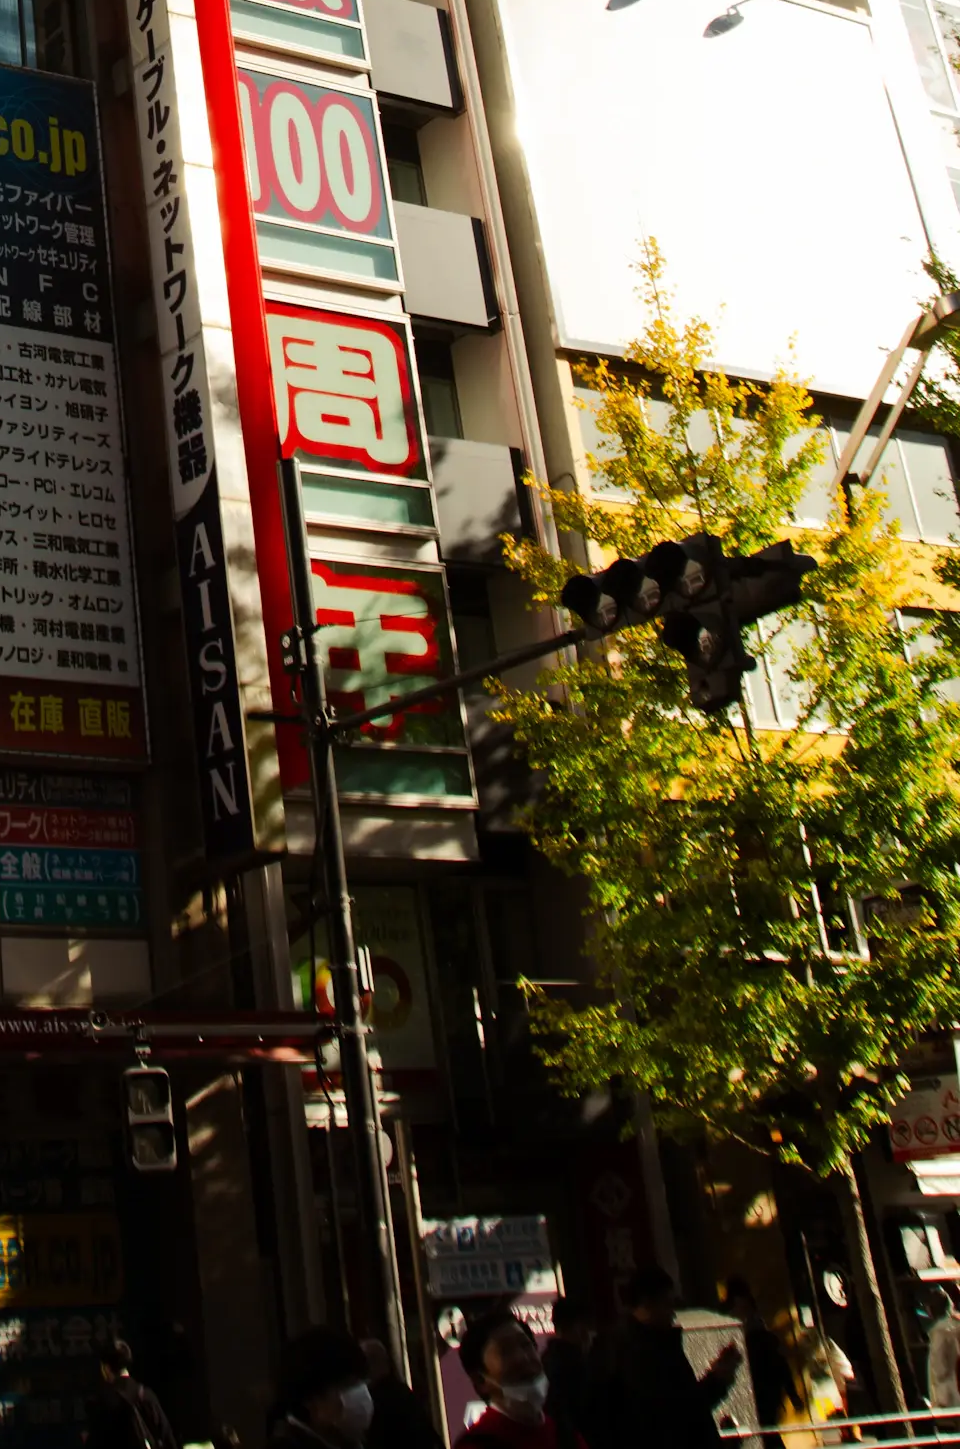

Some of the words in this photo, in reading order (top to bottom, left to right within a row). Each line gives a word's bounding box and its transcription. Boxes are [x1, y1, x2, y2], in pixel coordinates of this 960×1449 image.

[9, 692, 65, 734] 在庫
[78, 698, 133, 738] 直販
[188, 521, 241, 823] AISAN
